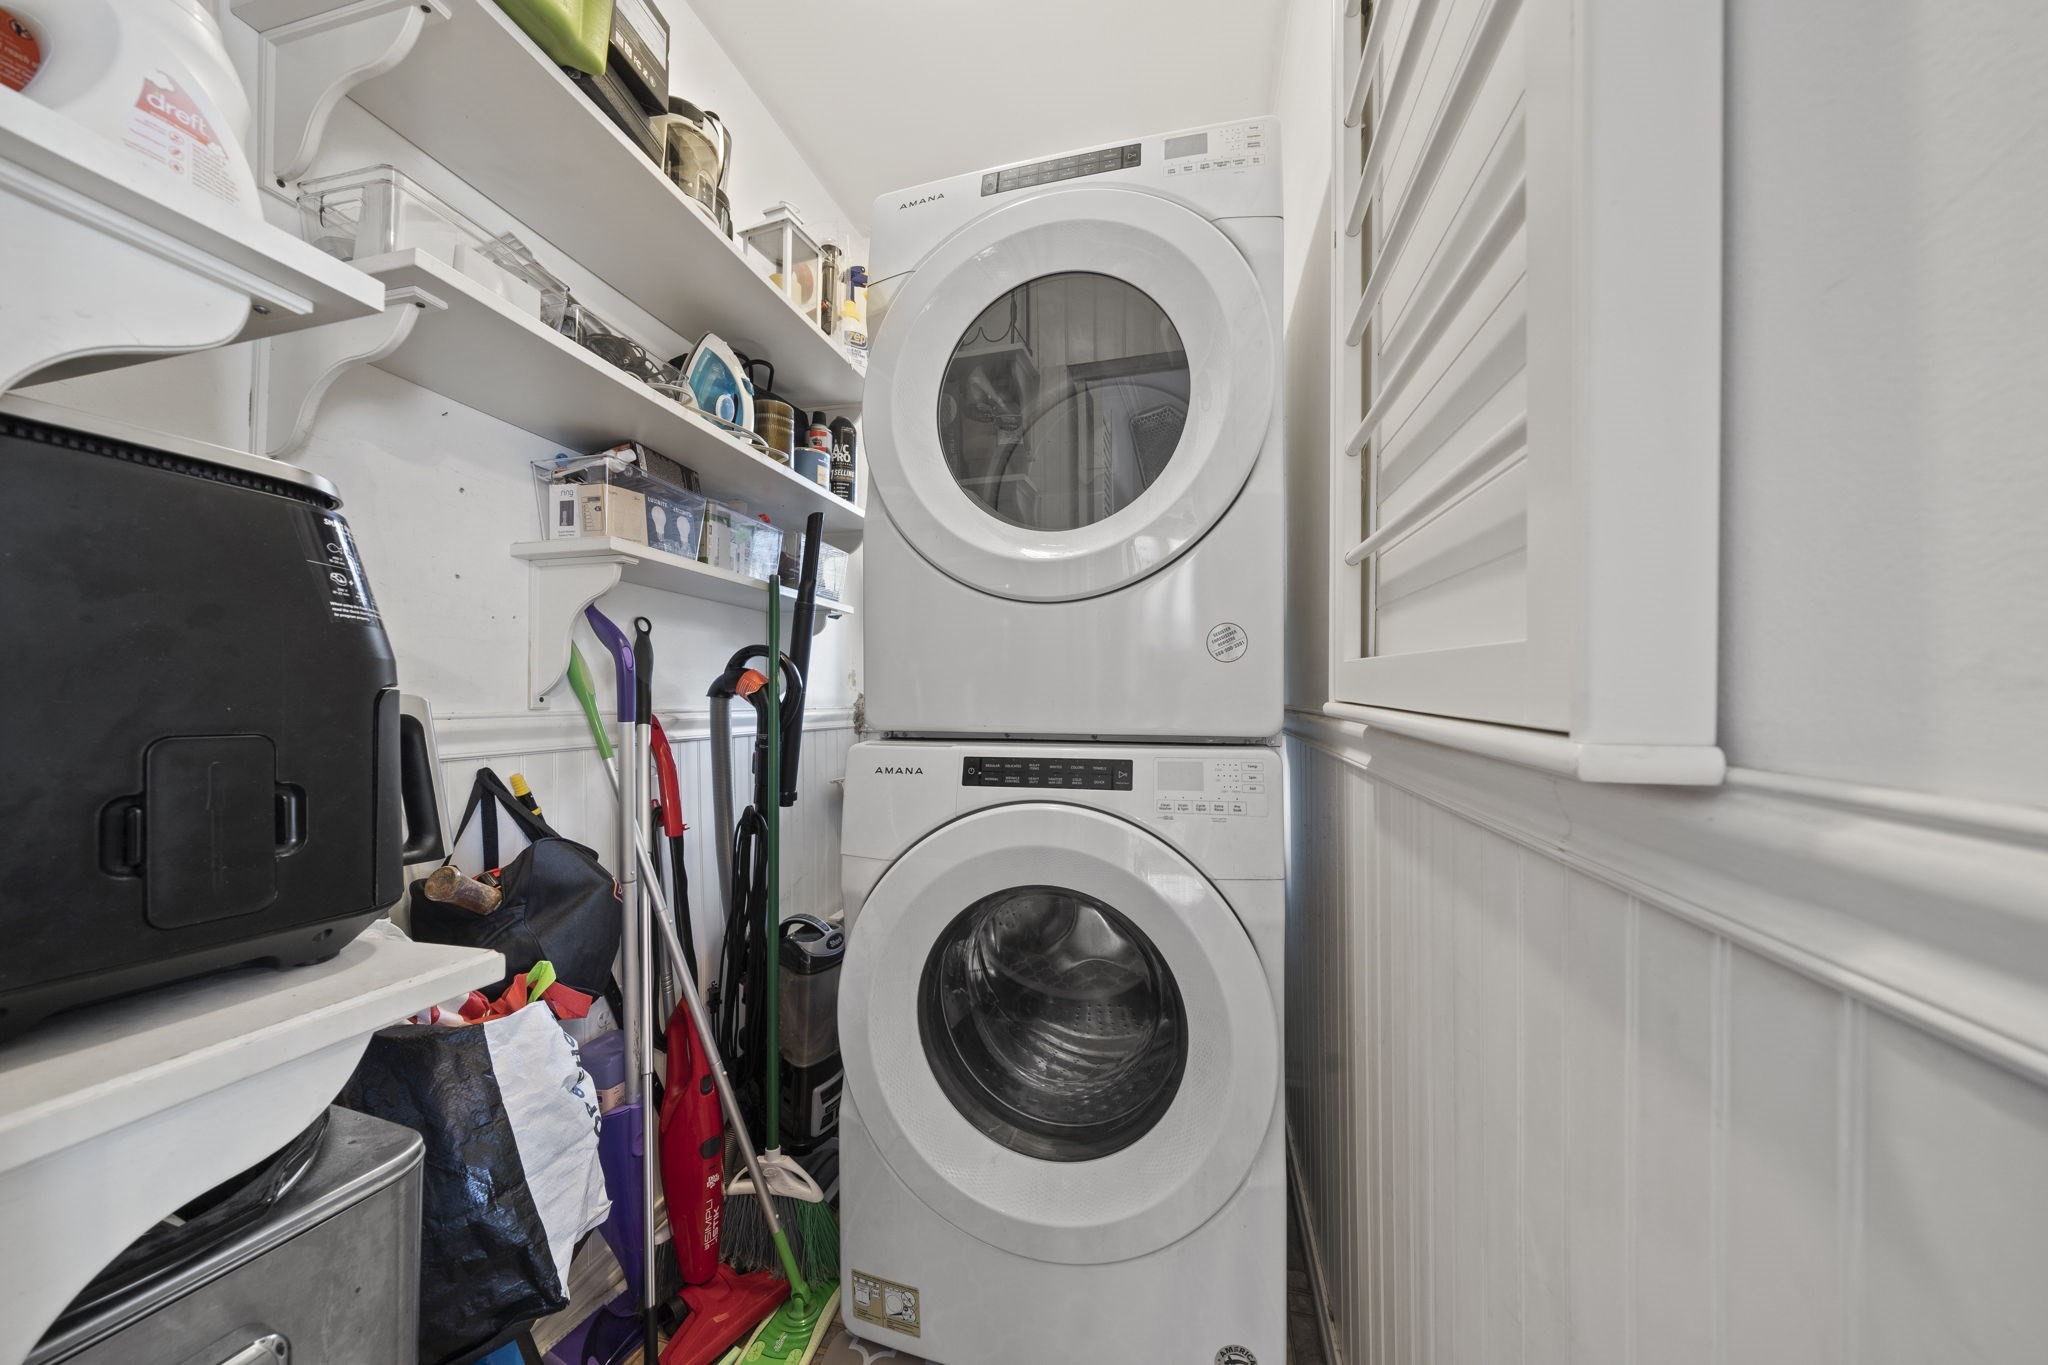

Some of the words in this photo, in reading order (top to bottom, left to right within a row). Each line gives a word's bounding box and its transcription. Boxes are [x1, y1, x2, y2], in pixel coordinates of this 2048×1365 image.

[147, 93, 210, 138] dreft
[899, 193, 945, 210] AMANA
[832, 443, 850, 454] A/C
[831, 453, 851, 463] PRO
[560, 489, 574, 498] ring
[874, 766, 924, 775] AMANA
